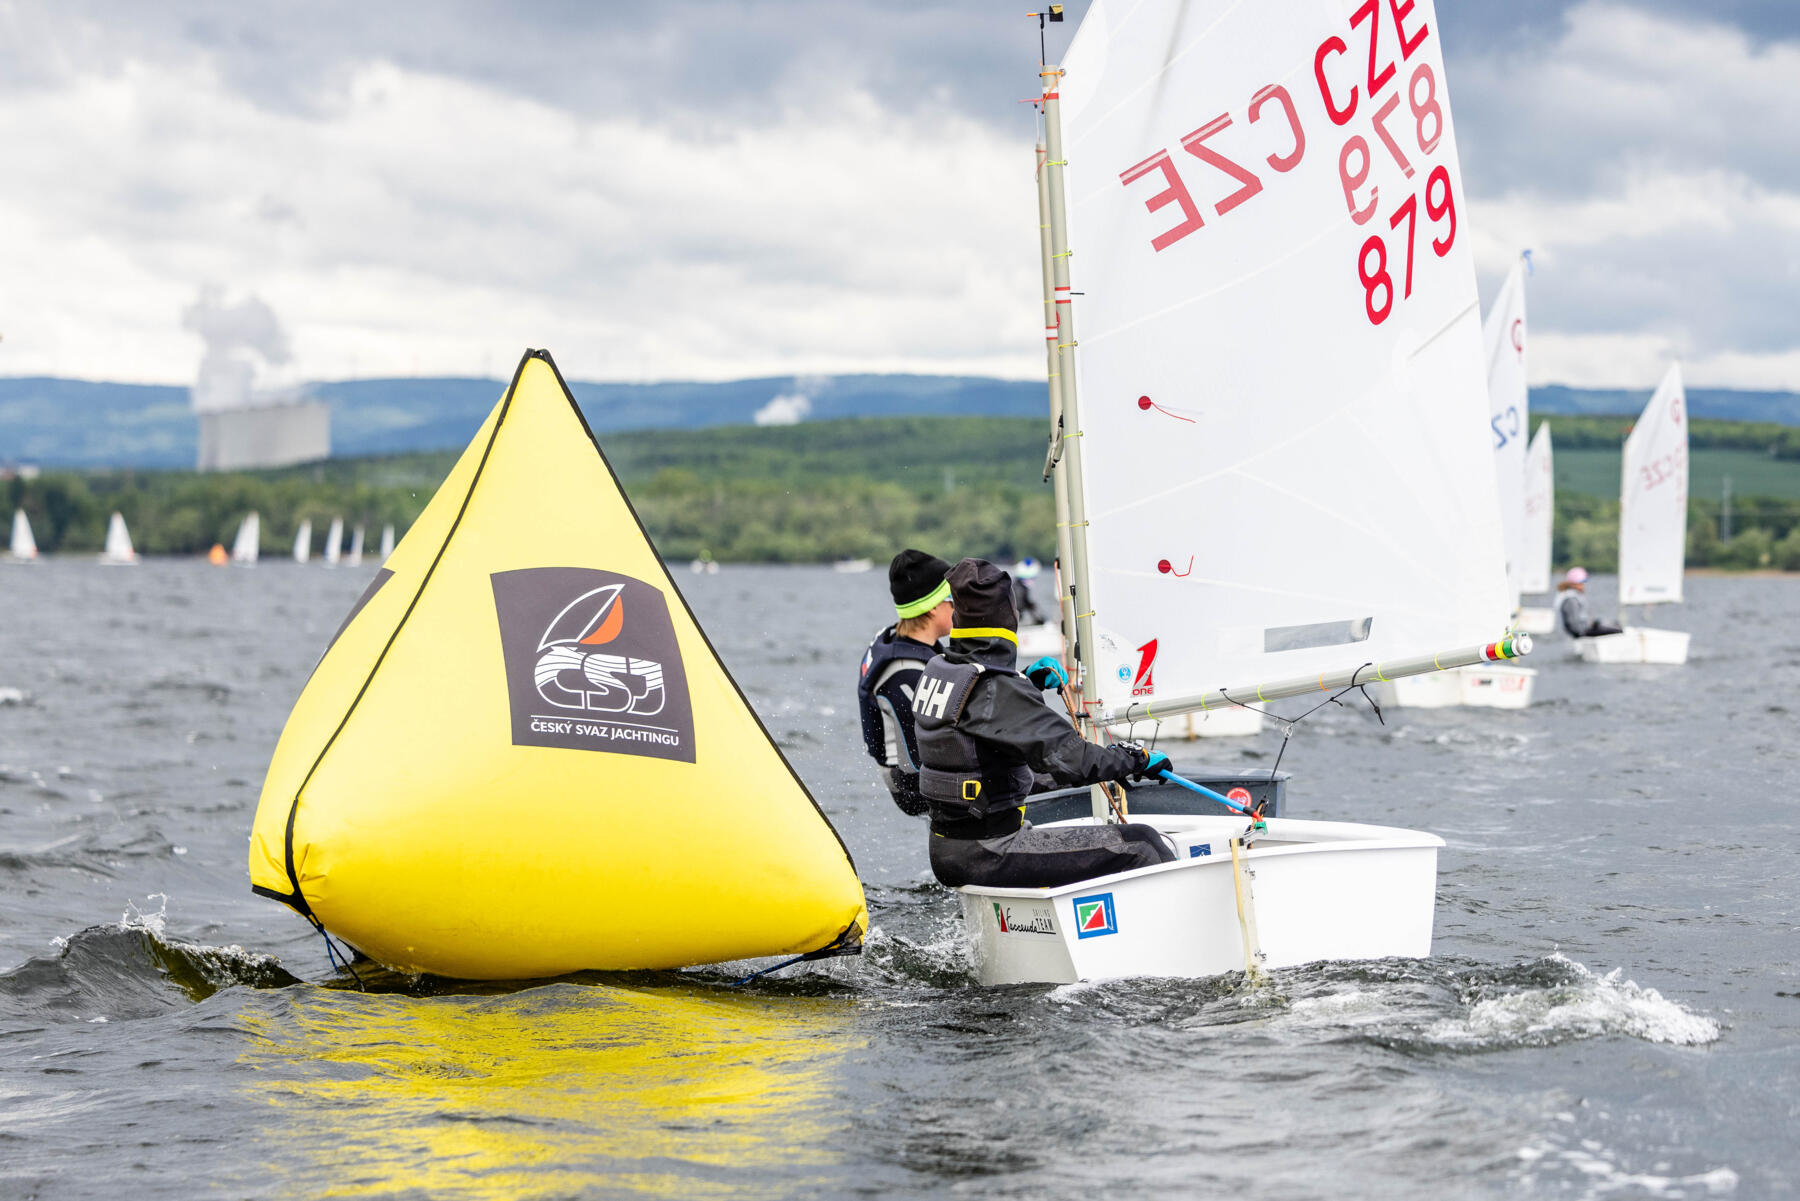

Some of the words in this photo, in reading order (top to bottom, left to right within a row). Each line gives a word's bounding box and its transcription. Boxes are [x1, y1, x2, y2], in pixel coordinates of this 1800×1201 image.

[1314, 0, 1429, 126] CZE
[1358, 164, 1457, 326] 879
[912, 675, 955, 719] HH
[1132, 687, 1154, 697] ONE
[531, 719, 573, 735] ČESKÝ
[576, 724, 608, 738] SVAZ
[611, 727, 680, 746] JACHTINGU
[1036, 918, 1054, 931] TEAM
